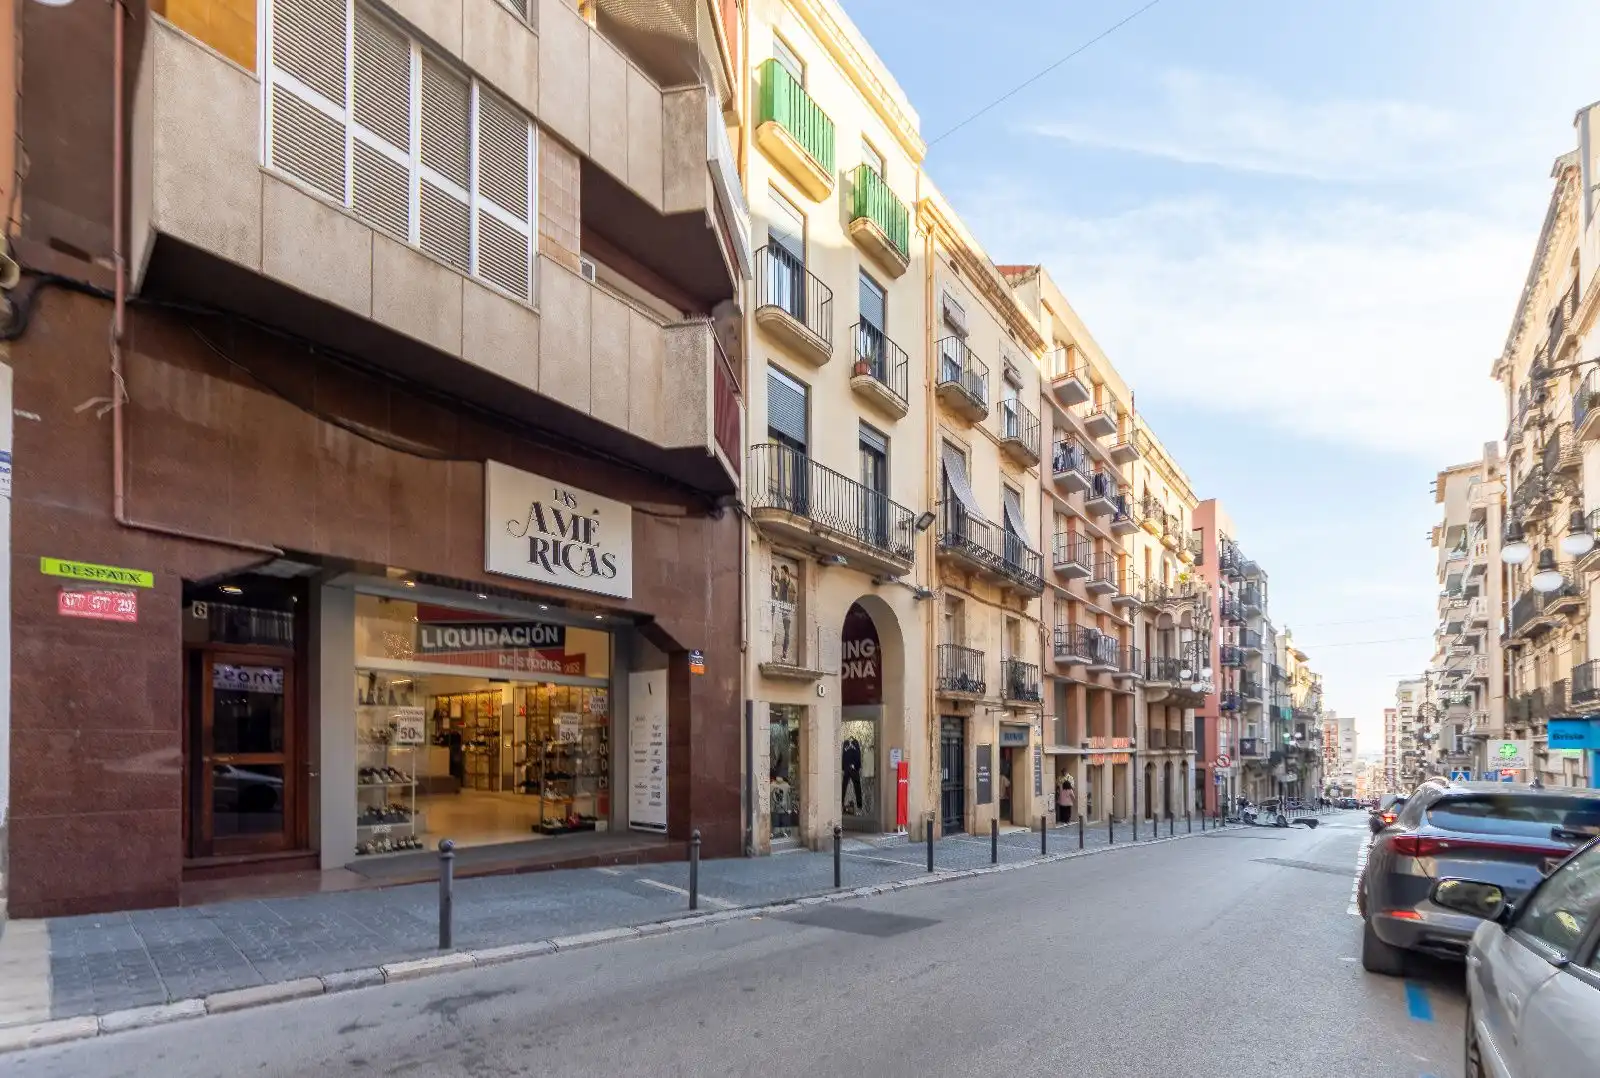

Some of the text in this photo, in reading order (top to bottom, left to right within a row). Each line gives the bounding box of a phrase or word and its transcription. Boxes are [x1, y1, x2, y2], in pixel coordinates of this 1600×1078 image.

[553, 488, 577, 509] LAS
[506, 500, 600, 548] AMÉ
[528, 535, 617, 579] RICAS
[194, 603, 205, 617] 6
[422, 622, 559, 648] LIQUIDACIÓN
[500, 653, 513, 667] DE
[517, 656, 561, 672] STOCKS
[400, 727, 423, 739] 50%
[560, 731, 577, 742] 50%
